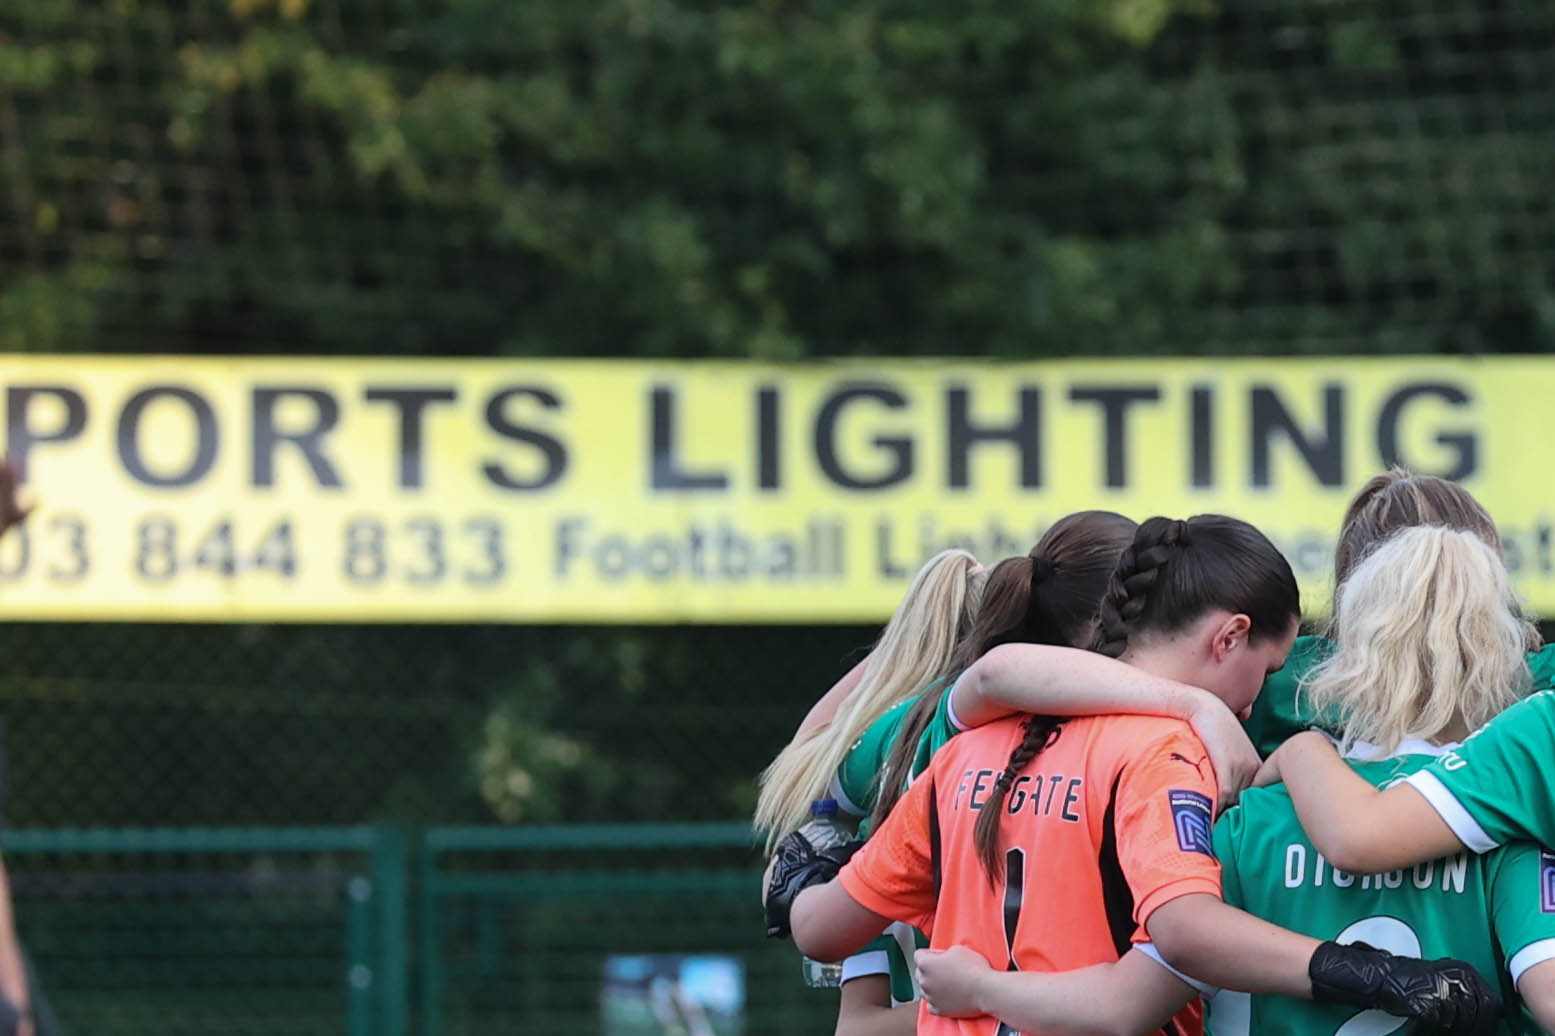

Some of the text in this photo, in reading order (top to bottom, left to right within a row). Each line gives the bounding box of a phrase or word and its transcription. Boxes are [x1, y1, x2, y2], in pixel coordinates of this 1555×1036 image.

[3, 379, 1483, 492] PORTS LIGHTING
[134, 515, 298, 585] 844
[342, 516, 508, 586] 833
[558, 515, 845, 582] Football
